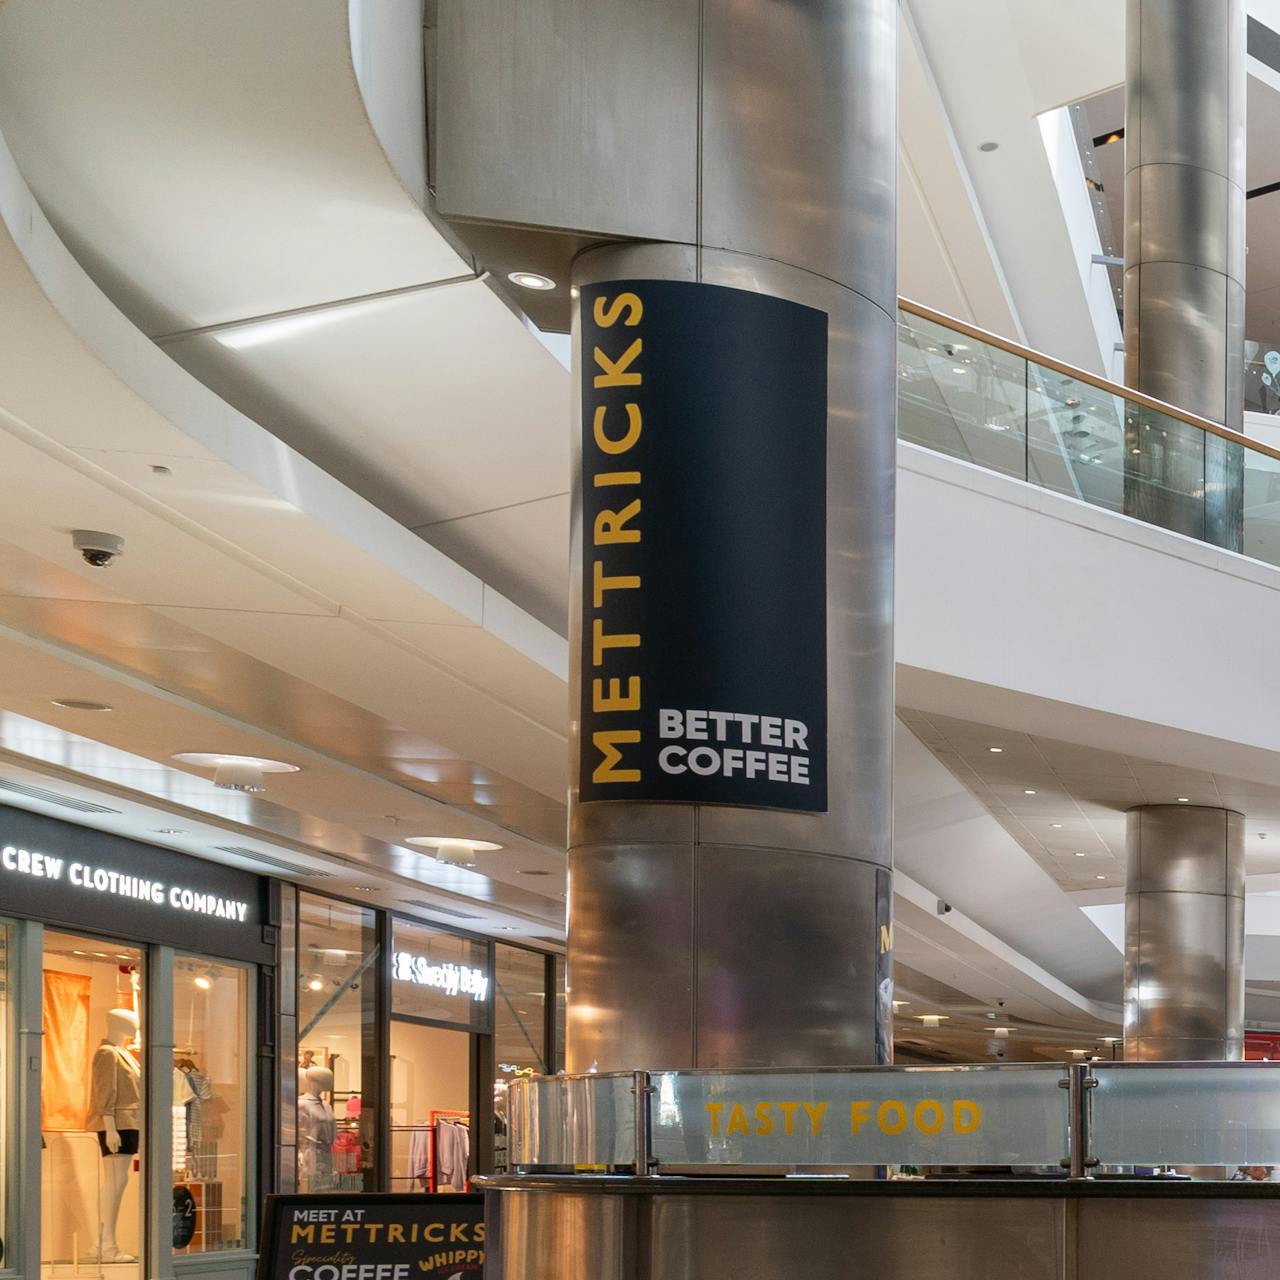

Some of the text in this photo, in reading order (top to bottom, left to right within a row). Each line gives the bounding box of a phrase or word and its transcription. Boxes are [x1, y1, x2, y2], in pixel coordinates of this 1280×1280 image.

[593, 291, 643, 784] METTRICKS
[659, 707, 809, 751] BETTER
[658, 745, 810, 785] COFFEE
[2, 847, 247, 922] CREW CLOTHING COMPANY
[705, 1099, 982, 1137] TASTY FOOD
[290, 1223, 485, 1244] METTRICKS
[293, 1209, 365, 1222] MEET AT
[418, 1249, 485, 1272] WHIPPY
